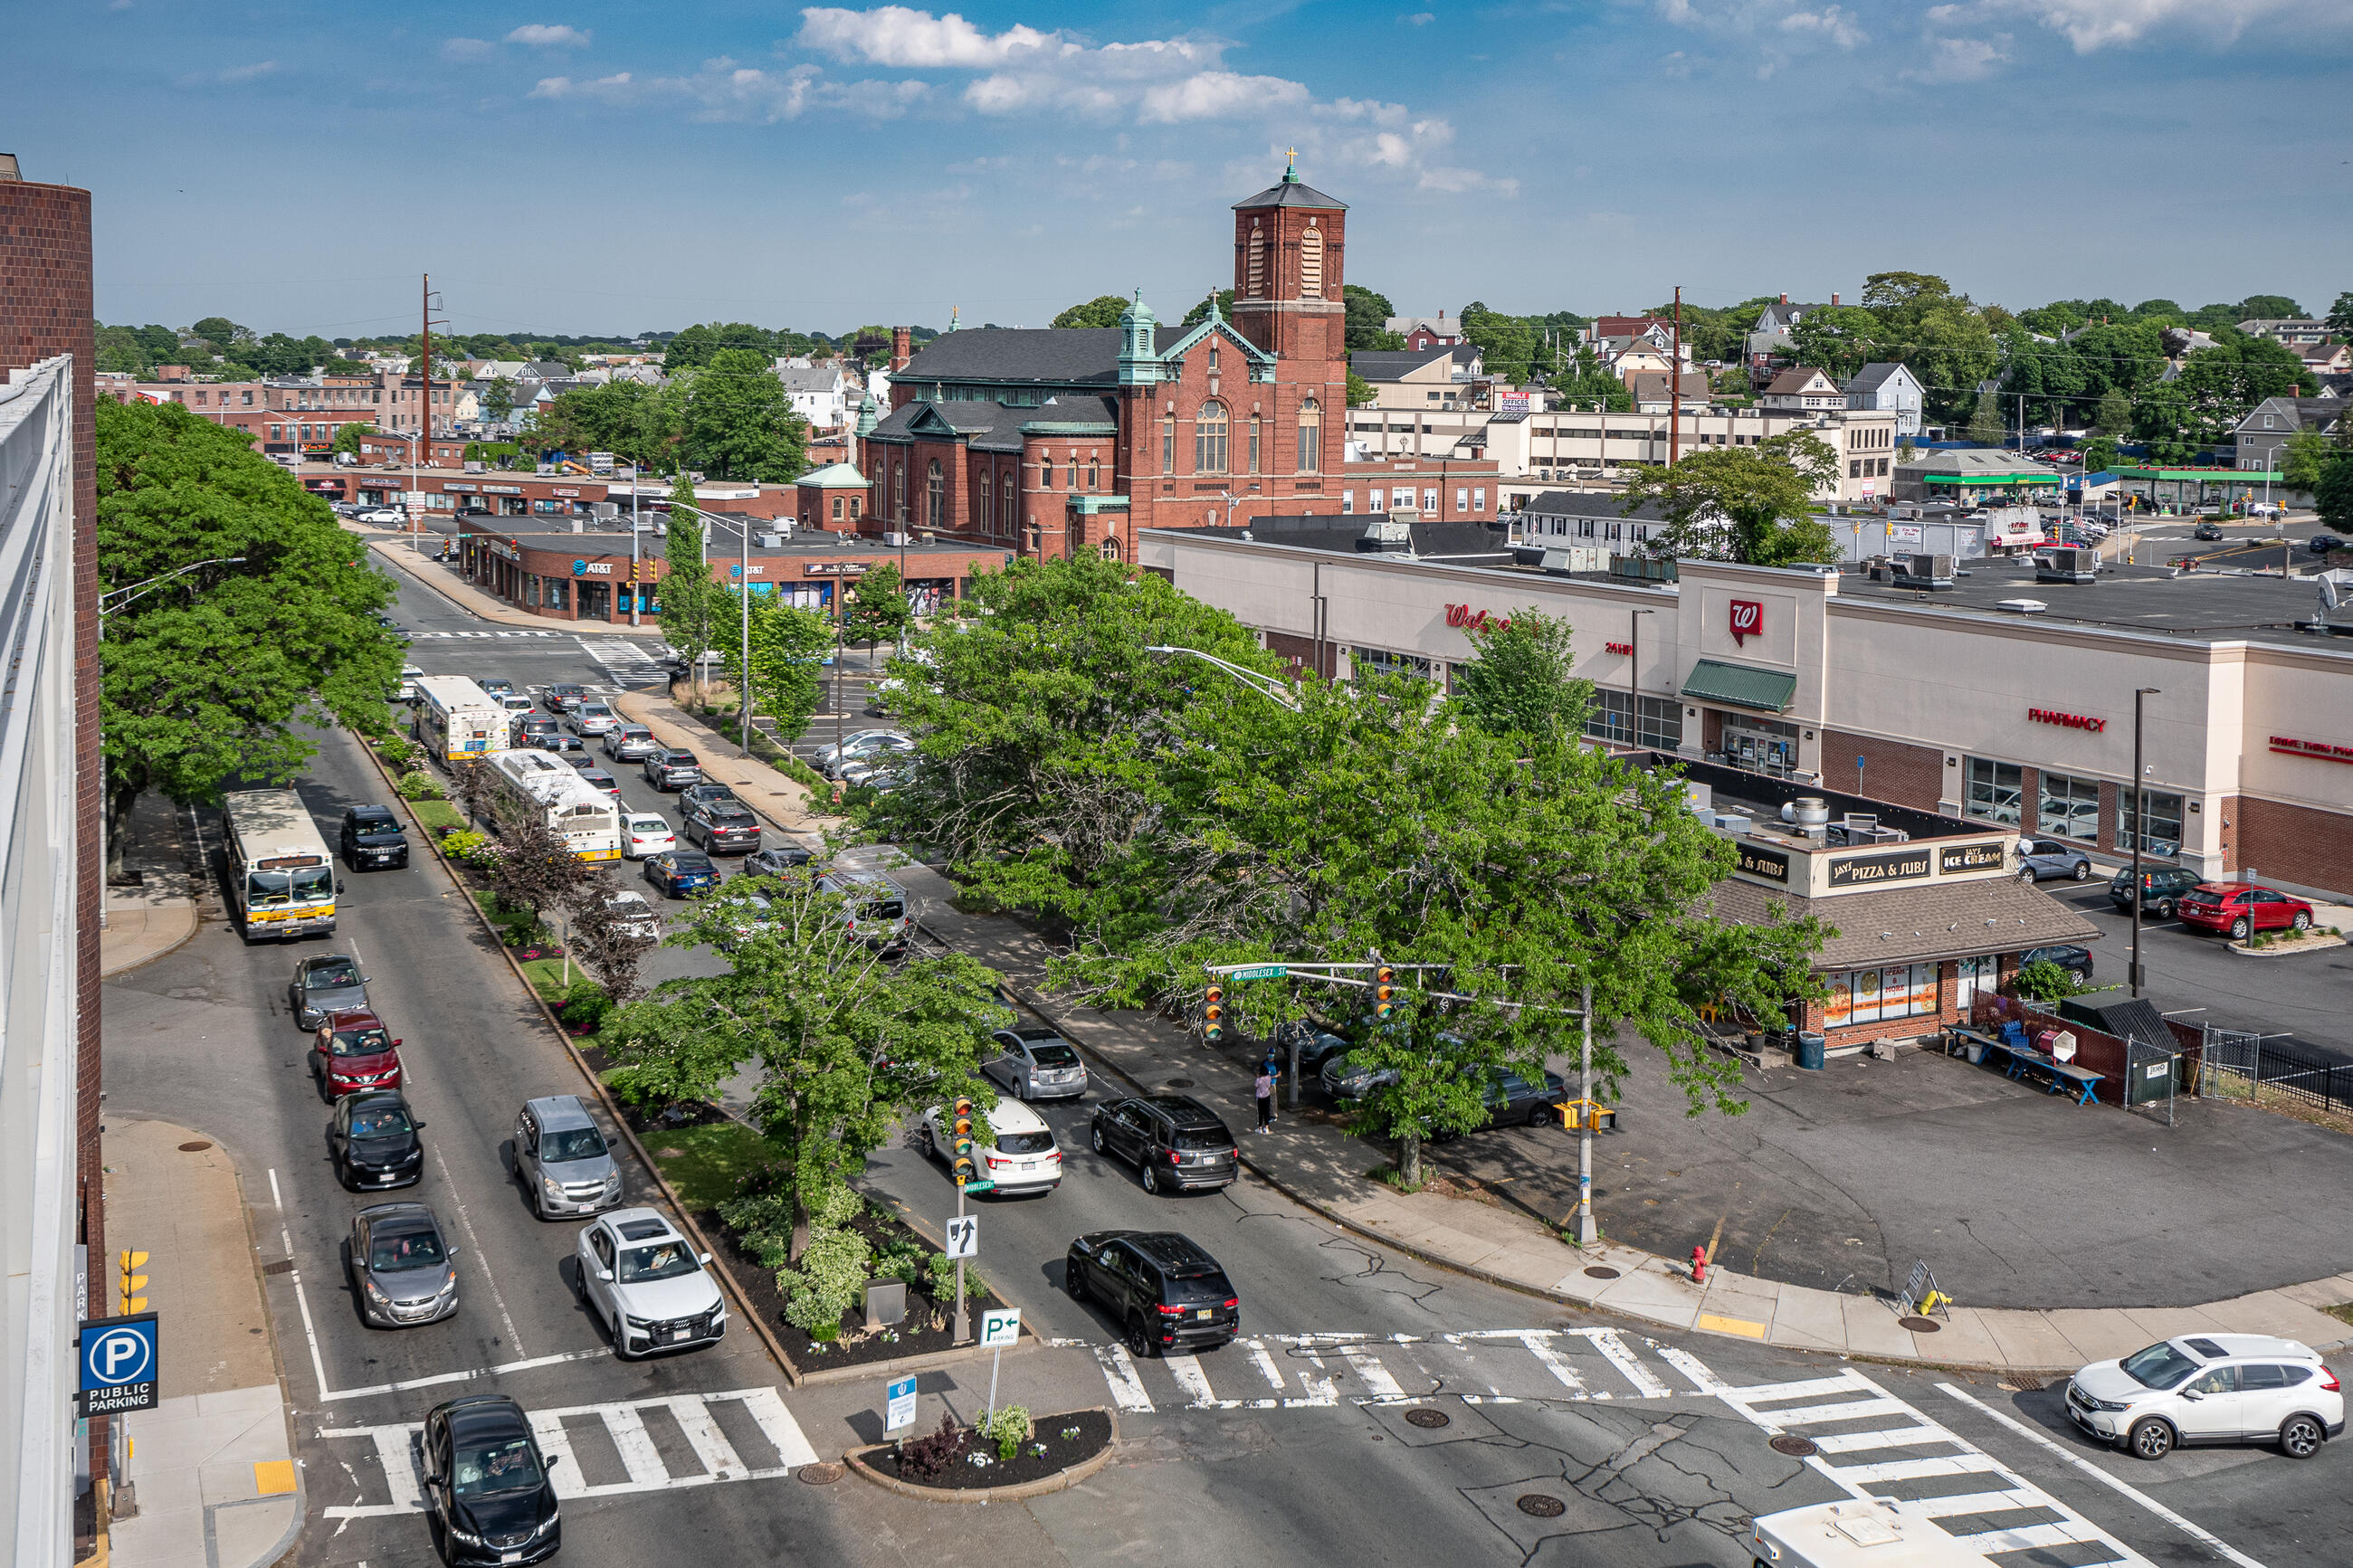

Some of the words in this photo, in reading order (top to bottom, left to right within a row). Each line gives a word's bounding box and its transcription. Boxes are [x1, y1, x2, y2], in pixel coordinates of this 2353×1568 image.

[586, 563, 613, 575] AT&T
[1732, 605, 1758, 628] W
[2028, 708, 2107, 732] PHARMACY
[2269, 736, 2301, 748] DRIVE
[2302, 741, 2331, 753] THRU
[1744, 856, 1754, 869] &
[1756, 860, 1784, 877] SUBS
[1944, 856, 1961, 868] ICE
[1964, 851, 2001, 866] CREAM
[1852, 866, 1885, 880] PIZZA
[1888, 864, 1897, 877] &
[1899, 860, 1928, 876] SUBS
[1243, 968, 1274, 979] MIDDLESEX
[1278, 967, 1286, 975] ST
[1885, 968, 1905, 976] CREAM
[1885, 984, 1905, 993] MORE
[986, 1318, 1003, 1341] P
[106, 1336, 137, 1375] P
[90, 1383, 149, 1401] PUBLIC
[89, 1394, 149, 1412] PARKING
